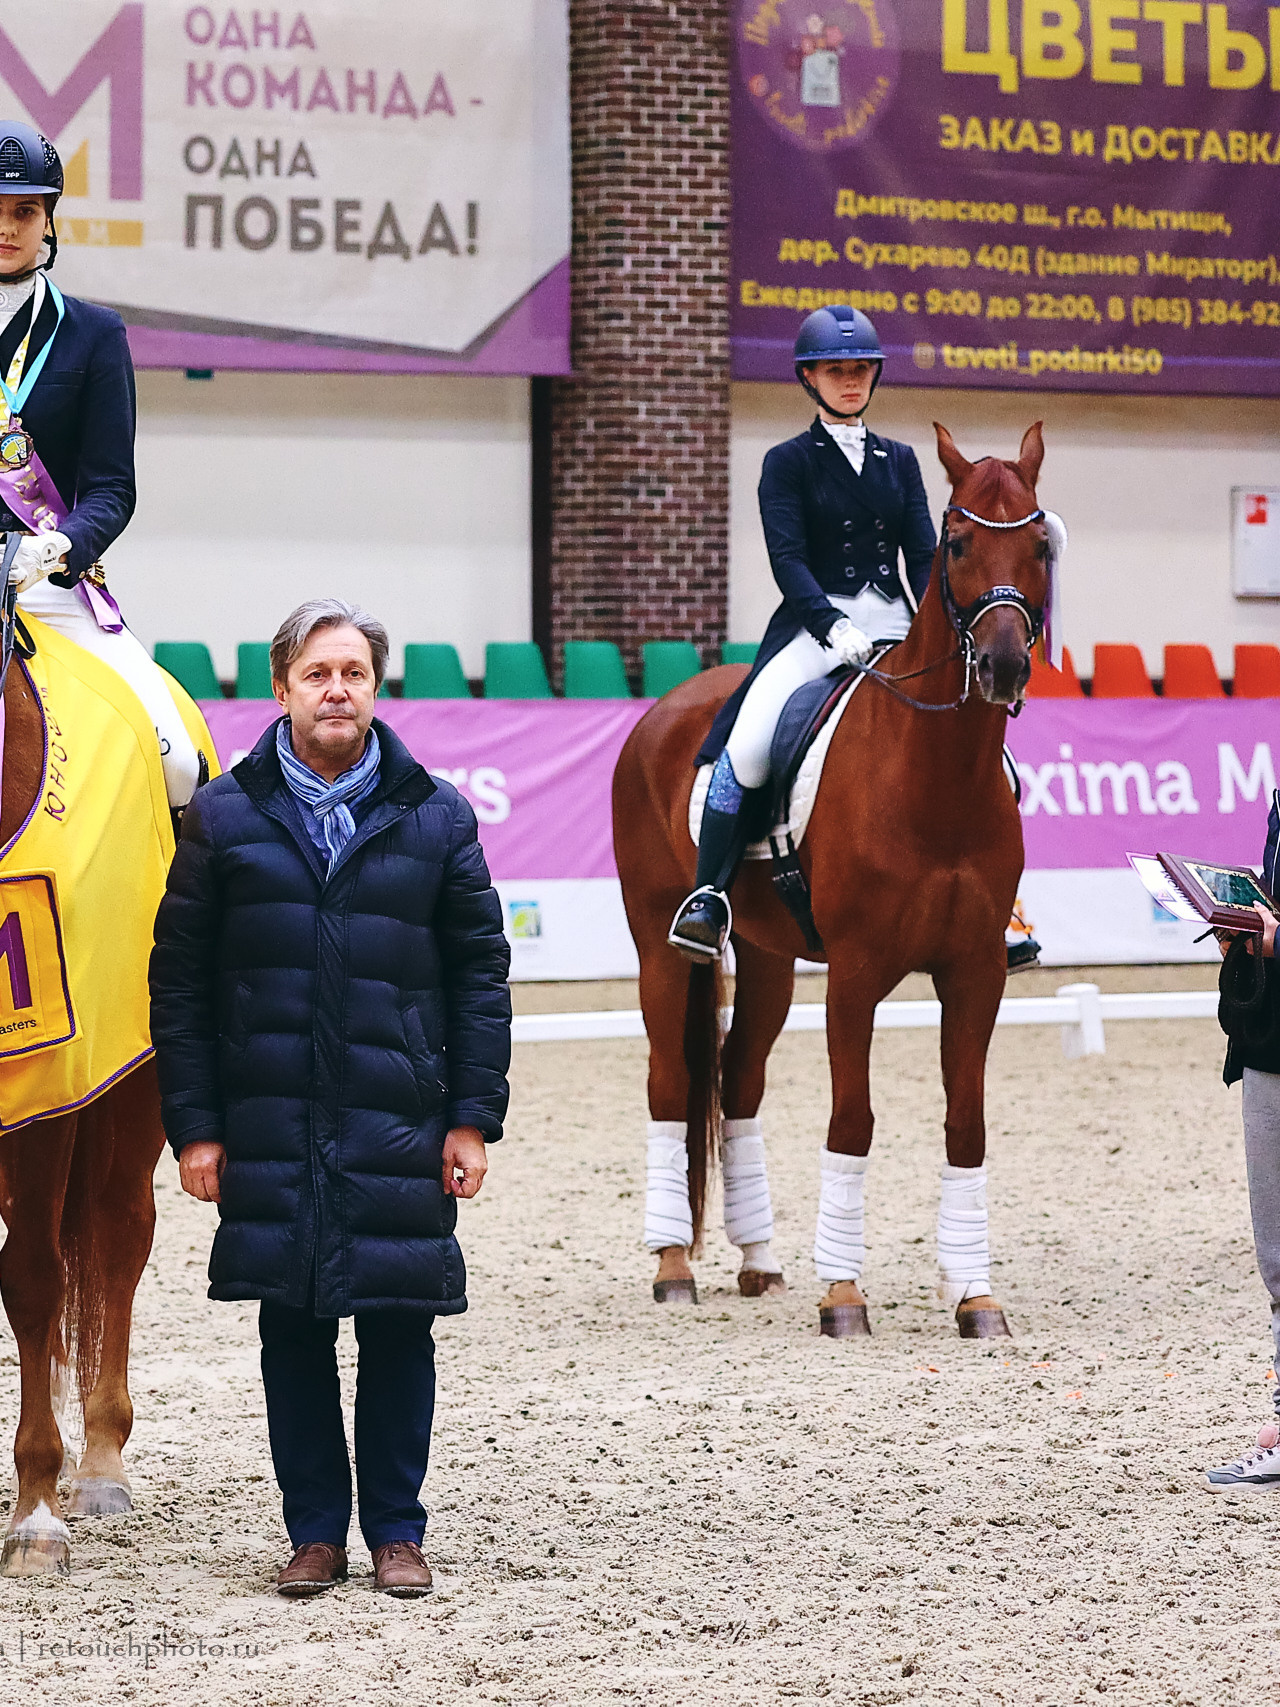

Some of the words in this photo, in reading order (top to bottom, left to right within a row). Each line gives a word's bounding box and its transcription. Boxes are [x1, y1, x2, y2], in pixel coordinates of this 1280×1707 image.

[184, 6, 317, 50] ОДНА
[185, 61, 457, 120] КОМАНДА
[938, 114, 1062, 155] ЗАКАЗ
[1071, 129, 1095, 156] и
[183, 135, 318, 180] ОДНА
[184, 194, 479, 261] ПОБЕДА!
[835, 189, 1019, 224] Дмитровское
[778, 238, 839, 267] дер.
[844, 236, 971, 272] Сухарево
[975, 244, 1031, 275] 40Д
[740, 279, 898, 312] Ежедневно
[926, 288, 982, 316] 9:00
[987, 296, 1021, 320] до
